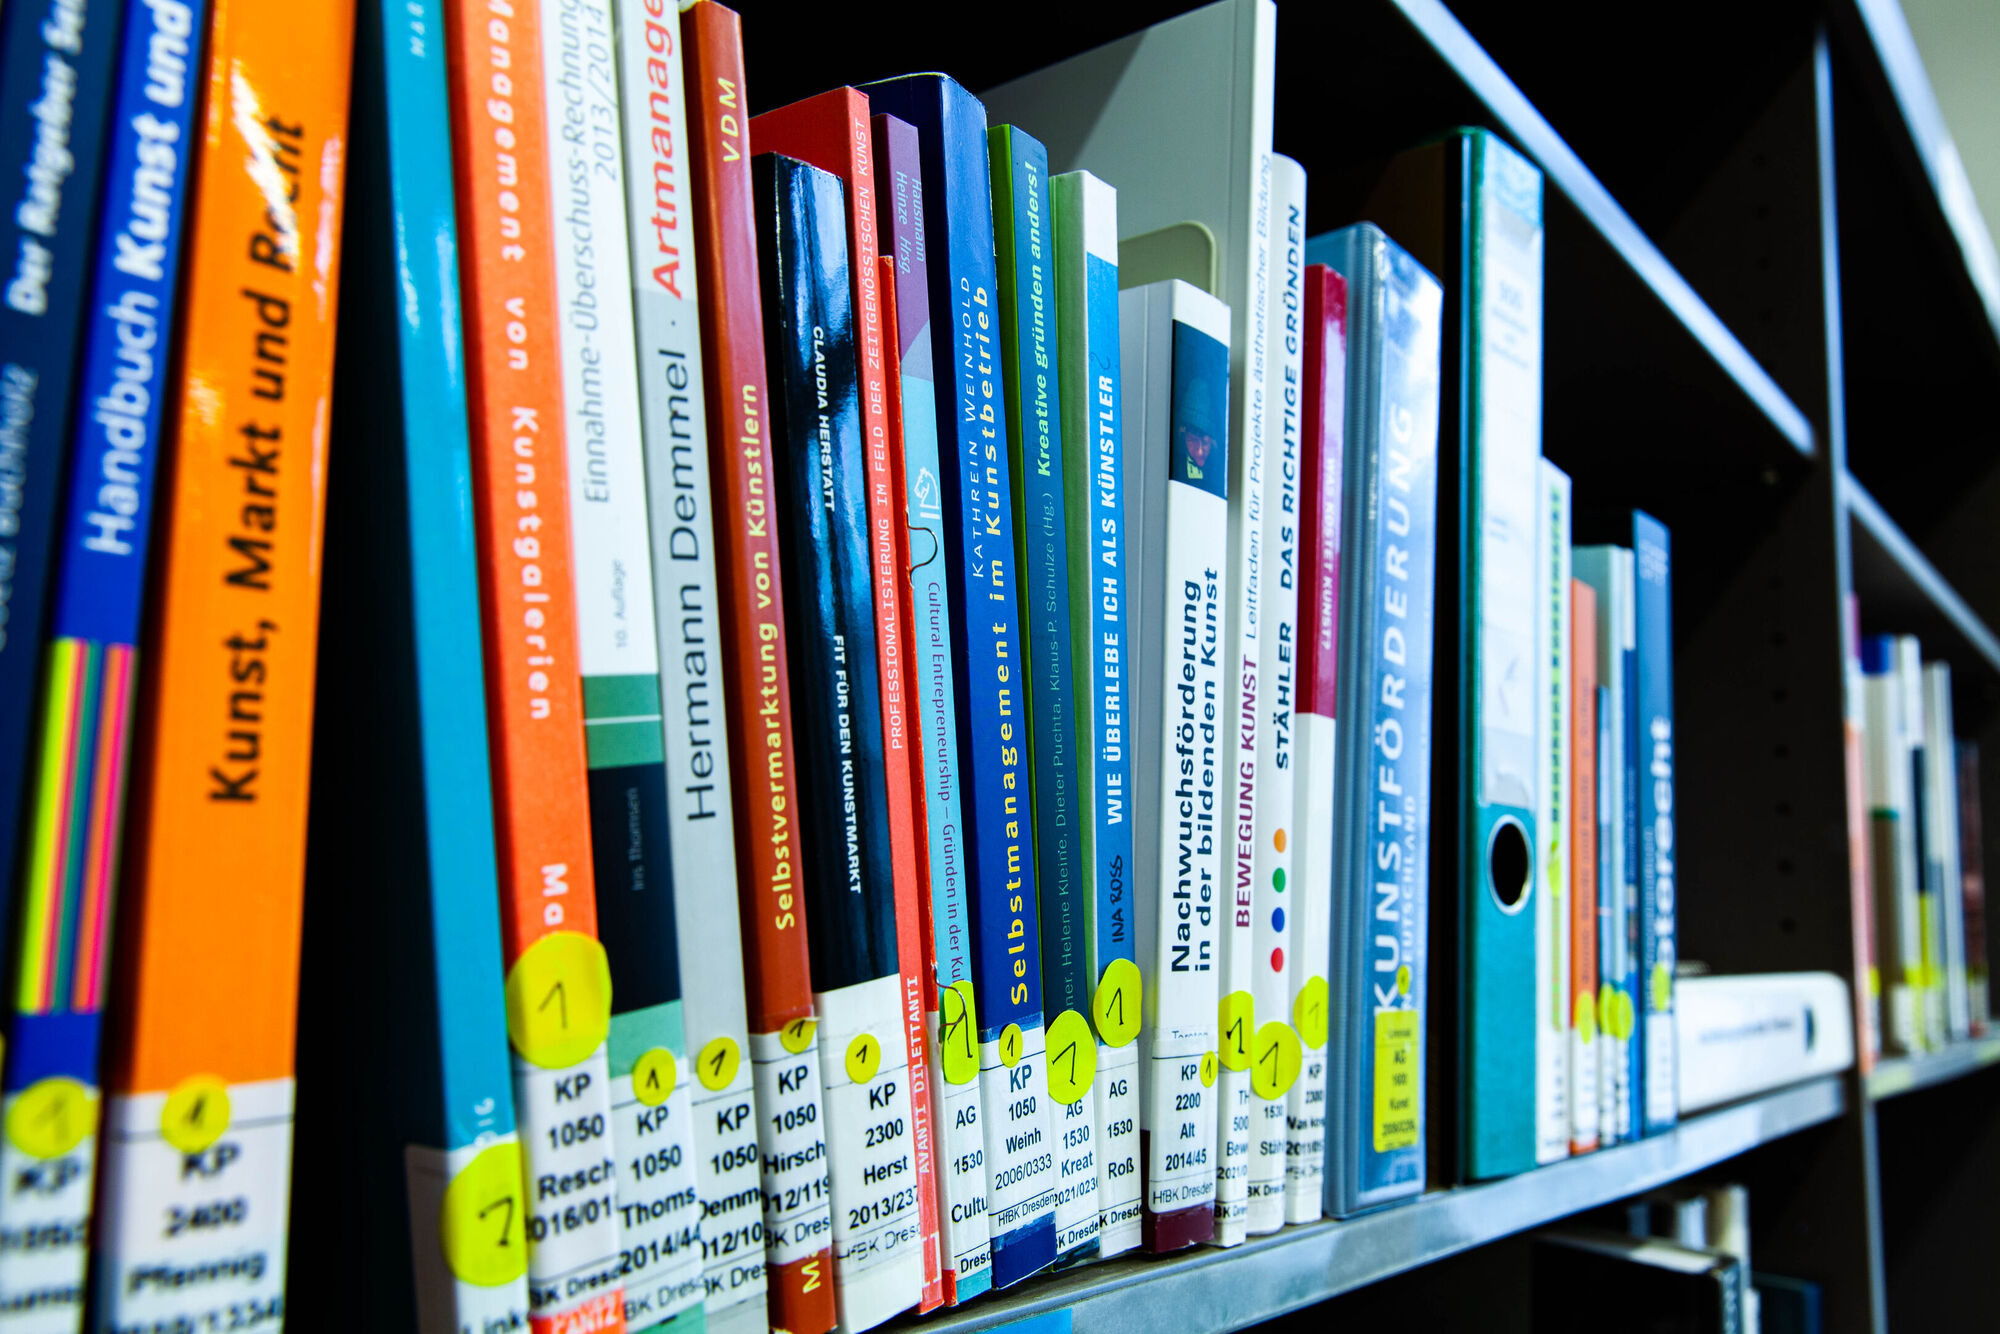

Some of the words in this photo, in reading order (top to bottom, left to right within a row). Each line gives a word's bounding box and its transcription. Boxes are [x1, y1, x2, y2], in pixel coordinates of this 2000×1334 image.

[584, 4, 617, 182] 2013/2014
[717, 77, 741, 163] VDM
[854, 120, 869, 176] KUNST
[114, 113, 180, 281] Kunst
[896, 170, 908, 226] Heinze
[911, 178, 925, 262] Hausmann
[1025, 161, 1042, 259] anders!
[1255, 154, 1272, 239] Bildung
[855, 187, 881, 367] ZEITGENÖSSISCHEN
[899, 235, 912, 276] Hrsg.
[1282, 204, 1301, 355] GRÜNDEN
[505, 297, 530, 371] von
[1031, 265, 1049, 369] gründen
[242, 288, 292, 402] und
[813, 325, 828, 409] CLAUDIA
[961, 277, 977, 422] WEINHOLD
[82, 289, 159, 556] Handbuch
[870, 381, 882, 415] DER
[974, 286, 1001, 536] Kunstbetrieb
[871, 427, 885, 472] FELD
[1032, 374, 1051, 477] Kreative
[1097, 375, 1116, 508] KÜNSTLER
[1248, 389, 1265, 483] Projekte
[1281, 366, 1299, 513] RICHTIGE
[658, 349, 700, 562] Demmel
[741, 383, 768, 538] Künstlern
[818, 415, 835, 512] HERSTATT
[224, 424, 282, 592] Markt
[875, 483, 888, 505] IM
[969, 441, 984, 578] KATHREIN
[1042, 492, 1055, 537] (Hg.)
[1247, 486, 1261, 521] für
[511, 406, 554, 721] Kunstgalerien
[1102, 519, 1117, 567] ALS
[1279, 525, 1294, 590] DAS
[751, 551, 771, 609] von
[990, 559, 1004, 601] im
[1045, 544, 1057, 612] Schulze
[1104, 578, 1118, 621] ICH
[1245, 536, 1260, 640] Leitfaden
[876, 519, 903, 749] PROFESSIONALISIERUNG
[927, 581, 944, 648] Cultural
[1201, 567, 1218, 667] Kunst
[1321, 575, 1333, 650] KUNST?
[832, 635, 846, 664] FIT
[1047, 619, 1060, 690] Klaus-P.
[208, 617, 281, 803] Kunst,
[678, 583, 717, 821] Hermann
[835, 669, 849, 708] FÜR
[1103, 632, 1121, 762] ÜBERLEBE
[1239, 655, 1258, 752] KUNST
[1274, 622, 1292, 770] STÄHLER
[1374, 401, 1412, 1015] KUNSTFÖRDERUNG
[838, 714, 851, 753] DEN
[931, 652, 952, 801] Entrepreneurship
[1051, 699, 1064, 766] Puchta,
[756, 622, 795, 932] Selbstvermarktung
[1172, 579, 1201, 974] Nachwuchsförderung
[1197, 680, 1217, 855] bildenden
[992, 622, 1028, 1006] Selbstmanagement
[1055, 771, 1066, 827] Dieter
[1107, 773, 1122, 824] WIE
[841, 761, 862, 894] KUNSTMARKT
[1235, 760, 1254, 928] BEWEGUNG
[942, 824, 956, 898] Gründen
[1058, 832, 1069, 896] Kleine,
[1110, 854, 1123, 904] ROSS
[948, 902, 961, 916] in
[1196, 866, 1212, 925] der
[947, 917, 961, 951] der
[1060, 901, 1072, 967] Helene
[1112, 910, 1124, 943] INA
[1195, 940, 1210, 972] in
[539, 981, 567, 1029] 1
[1106, 987, 1124, 1025] 1
[856, 1044, 868, 1063] 1
[906, 976, 926, 1094] DILETTANTI
[1007, 1033, 1014, 1057] 1
[1227, 1017, 1244, 1054] 1
[710, 1049, 726, 1077] 1
[779, 1065, 808, 1095] KP
[1010, 1064, 1032, 1094] KP
[1052, 1041, 1076, 1085] 1
[1181, 1065, 1197, 1081] KP
[1259, 1041, 1279, 1087] 1
[1309, 1064, 1321, 1079] KP
[555, 1073, 591, 1104] KP
[869, 1082, 897, 1110] KP
[1008, 1096, 1036, 1122] 1050
[1066, 1099, 1083, 1120] AG
[1109, 1079, 1128, 1099] AG
[1176, 1092, 1200, 1111] 2200
[548, 1114, 606, 1150] 1050
[637, 1105, 670, 1136] KP
[717, 1103, 750, 1135] KP
[773, 1103, 816, 1134] 1050
[865, 1118, 904, 1148] 2300
[911, 1103, 930, 1174] AVANTI
[955, 1105, 976, 1129] AG
[1006, 1128, 1042, 1154] Weinh
[1063, 1125, 1090, 1150] 1530
[1107, 1118, 1133, 1139] 1530
[1180, 1123, 1195, 1139] Alt
[631, 1145, 683, 1182] 1050
[711, 1143, 758, 1175] 1050
[763, 1140, 826, 1175] Hirsch
[864, 1155, 909, 1186] Herst
[953, 1149, 983, 1176] 1530
[995, 1153, 1052, 1191] 2006/0333
[1061, 1151, 1093, 1178] Kreat
[1108, 1156, 1135, 1179] Roß
[1166, 1149, 1207, 1171] 2014/45
[619, 1187, 696, 1229] Thoms
[951, 1194, 988, 1223] Cultu
[998, 1206, 1021, 1227] HfBK
[1022, 1194, 1055, 1217] Dresden
[1153, 1187, 1179, 1204] HfBK
[1182, 1182, 1213, 1200] Dresden
